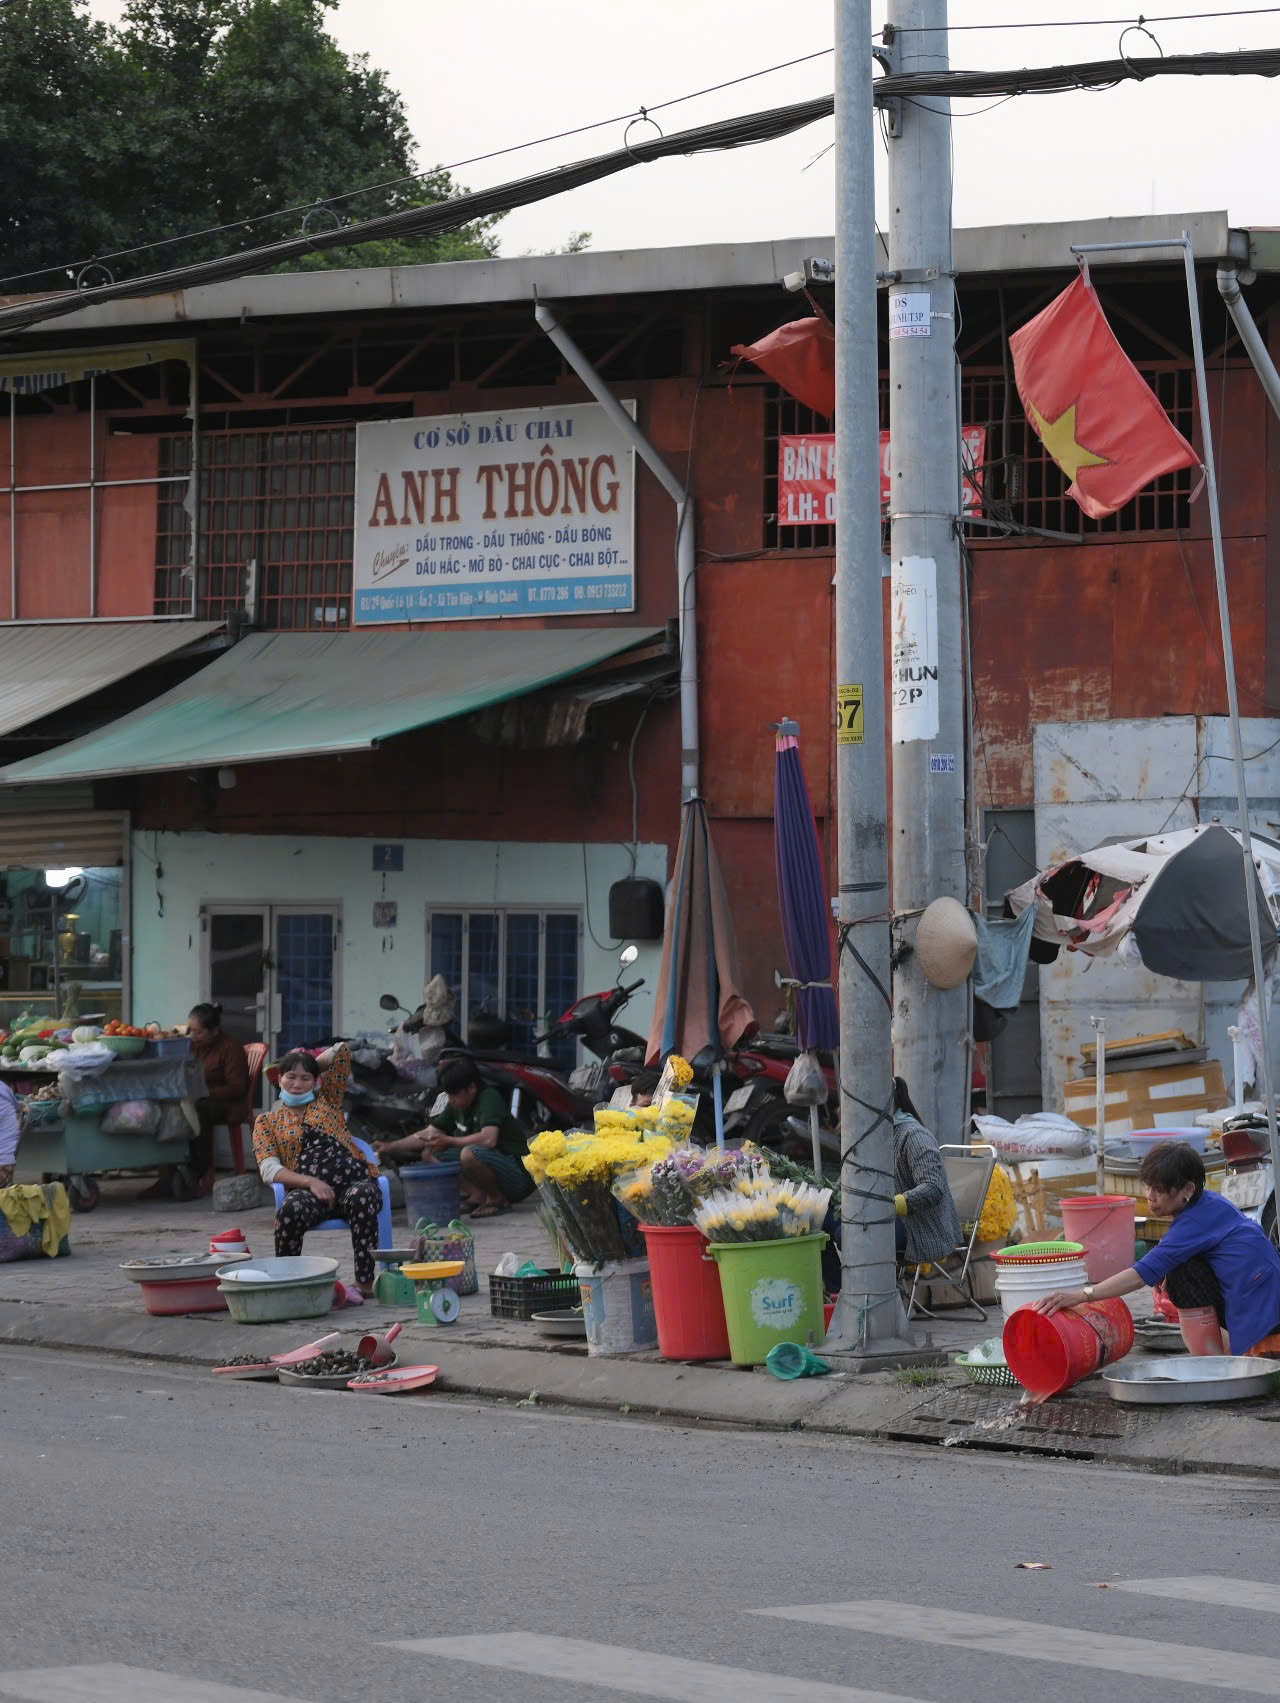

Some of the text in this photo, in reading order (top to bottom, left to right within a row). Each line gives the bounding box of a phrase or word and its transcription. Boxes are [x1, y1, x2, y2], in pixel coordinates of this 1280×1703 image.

[413, 427, 440, 450] CƠ
[445, 420, 471, 447] SỞ
[525, 419, 574, 440] CHAI
[783, 438, 822, 482] BÁN
[368, 443, 621, 527] ANH THÔNG
[787, 493, 819, 521] LH:
[440, 535, 474, 550] TRONG
[510, 528, 545, 546] THÔNG
[581, 524, 612, 542] BÓNG
[512, 556, 536, 570] CHAI
[539, 554, 560, 571] CỤC
[569, 552, 594, 567] CHAI
[762, 1294, 794, 1310] Surf
